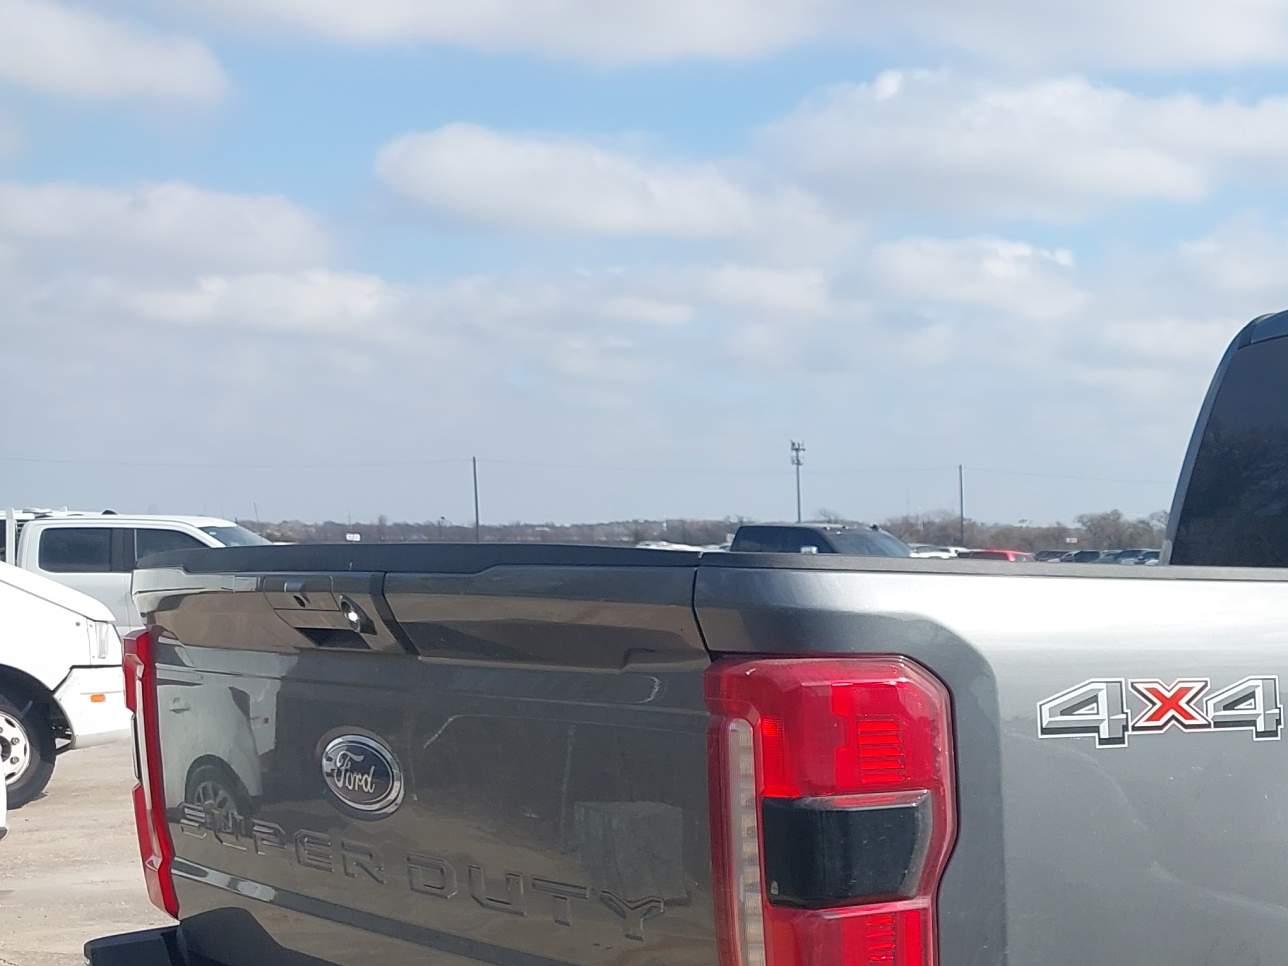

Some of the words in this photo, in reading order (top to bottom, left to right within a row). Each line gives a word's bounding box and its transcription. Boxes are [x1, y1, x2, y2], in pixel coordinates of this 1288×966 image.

[334, 750, 376, 793] Ford
[177, 801, 386, 885] SUPER
[405, 854, 665, 941] DUTY
